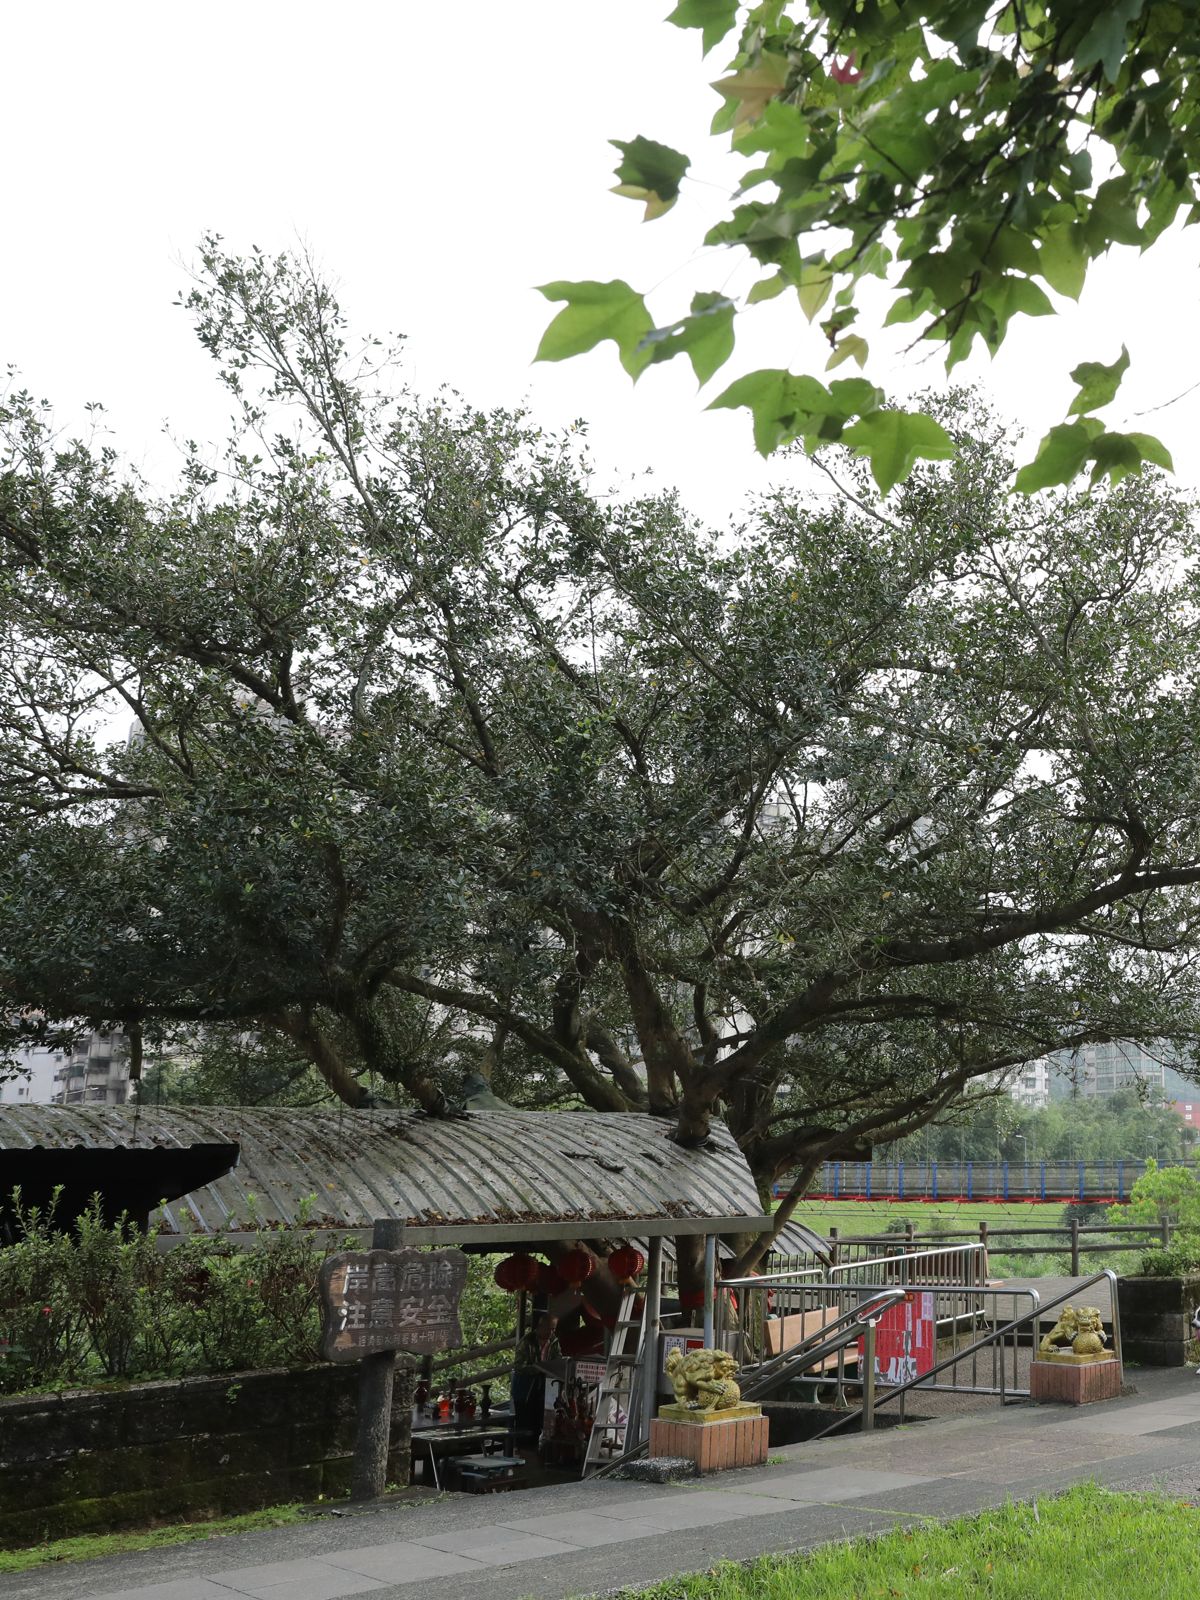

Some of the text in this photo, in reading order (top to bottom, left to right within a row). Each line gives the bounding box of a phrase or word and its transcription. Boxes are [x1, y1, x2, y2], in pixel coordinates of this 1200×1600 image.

[342, 1260, 454, 1294] 岸高危險
[340, 1294, 452, 1331] 注意安全
